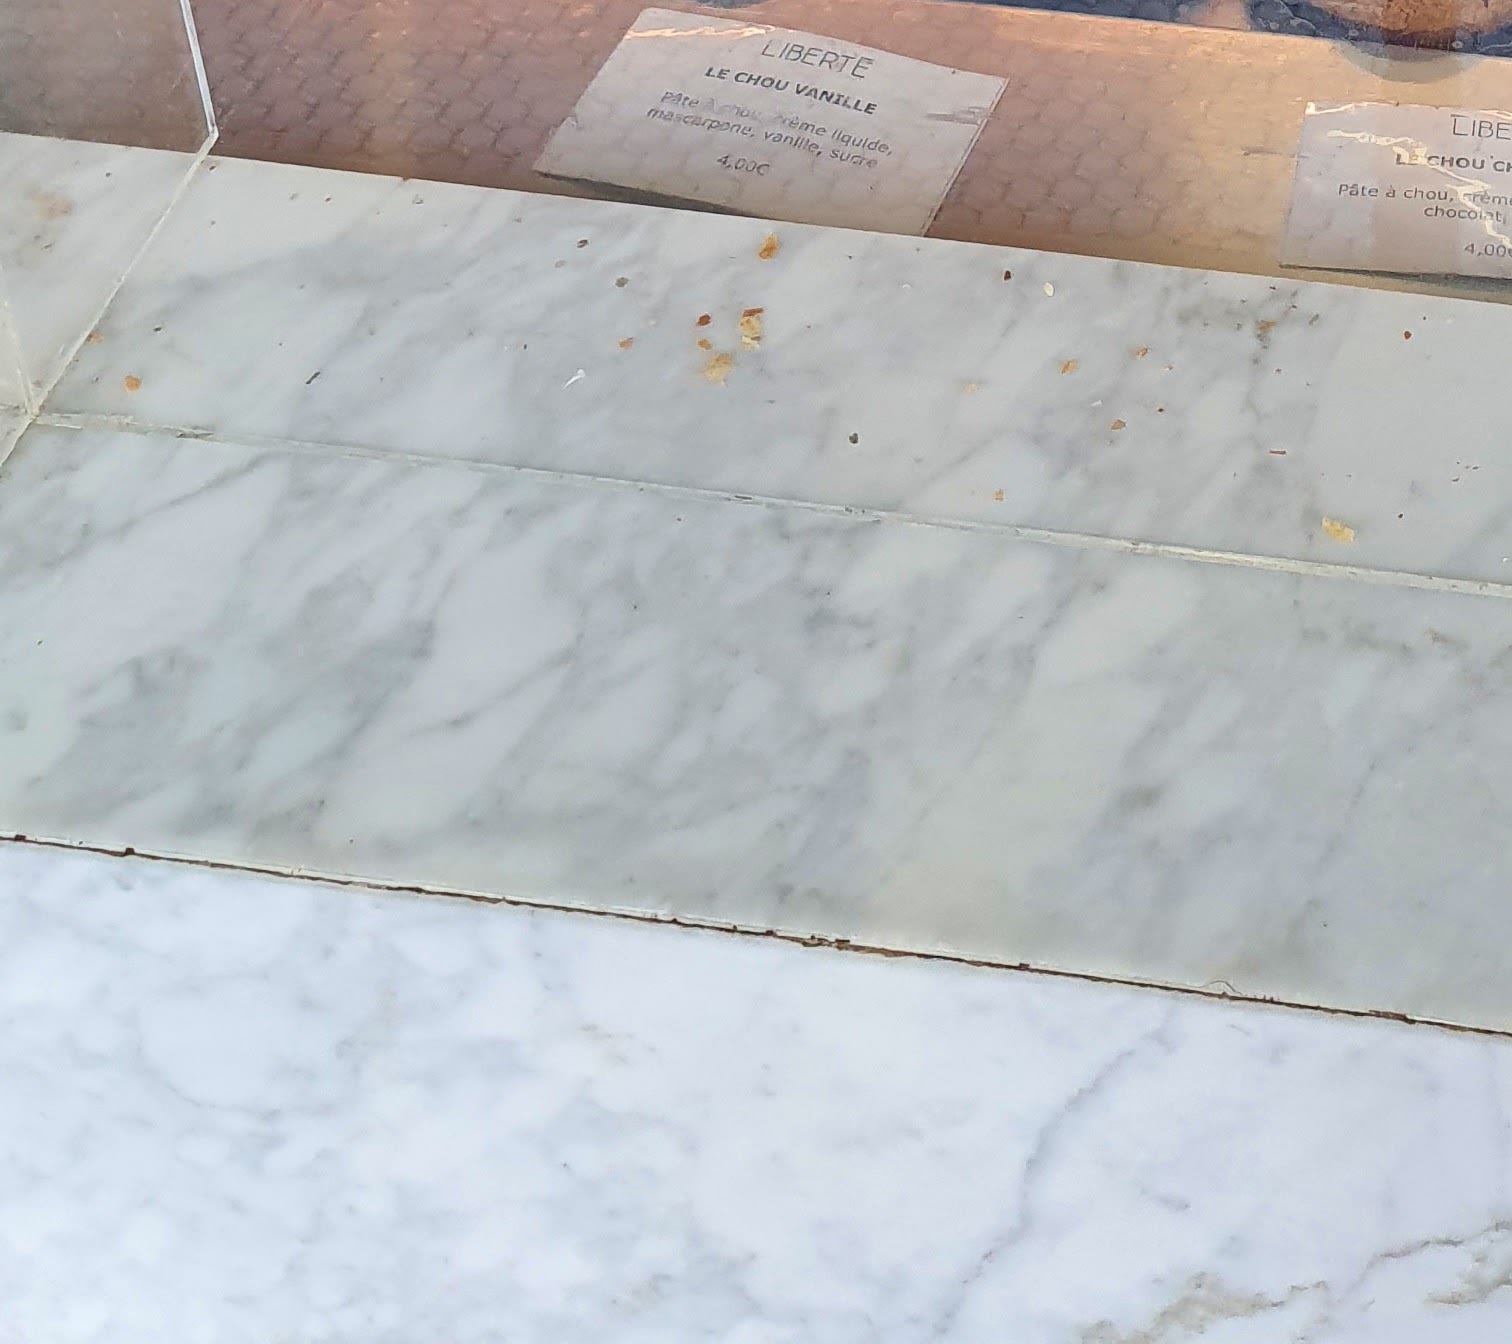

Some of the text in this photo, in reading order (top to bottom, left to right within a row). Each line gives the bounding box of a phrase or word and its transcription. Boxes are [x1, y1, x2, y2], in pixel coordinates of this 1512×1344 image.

[705, 66, 878, 115] LE CHOU VANILLE
[647, 107, 878, 169] mascarpone, vanille, sucre
[831, 128, 893, 156] liquide,
[1427, 154, 1486, 170] CHOU
[1338, 183, 1379, 198] Pâte
[1385, 185, 1396, 198] à
[1403, 187, 1454, 203] chou,
